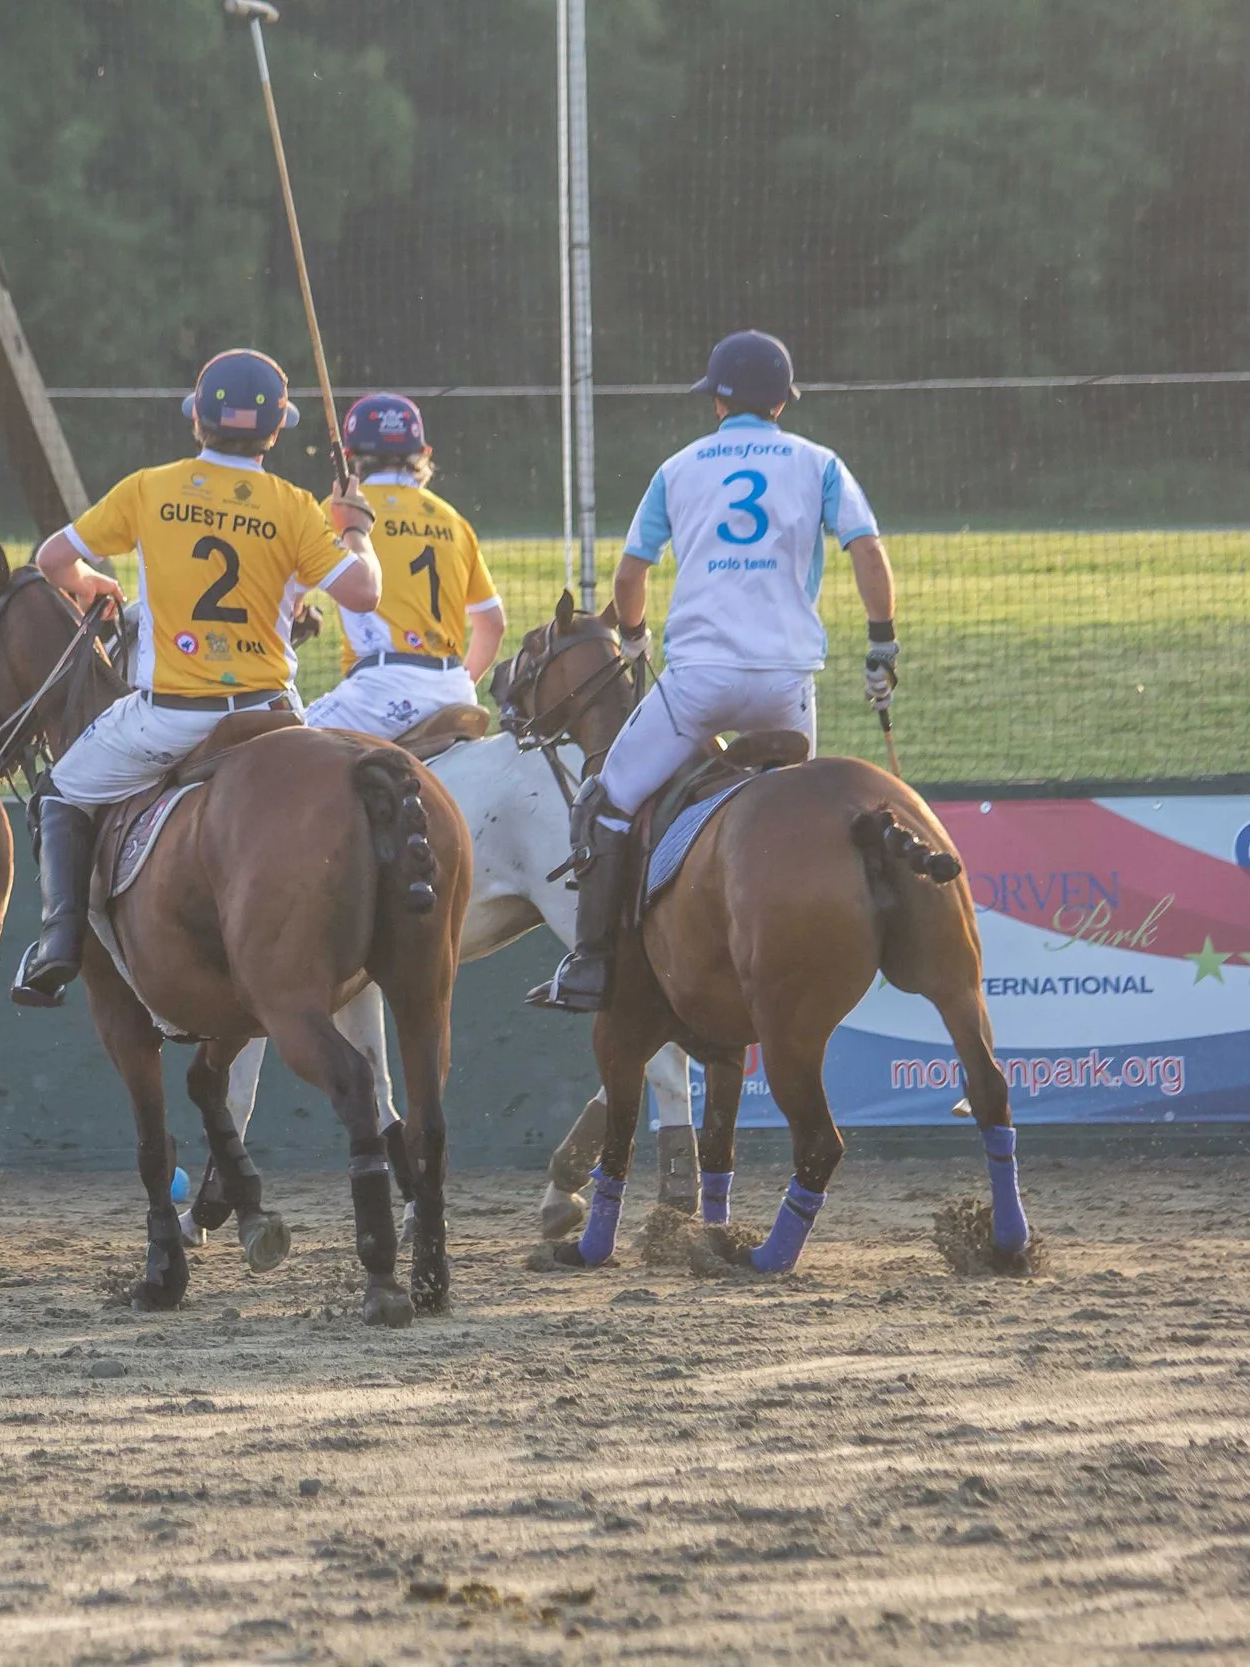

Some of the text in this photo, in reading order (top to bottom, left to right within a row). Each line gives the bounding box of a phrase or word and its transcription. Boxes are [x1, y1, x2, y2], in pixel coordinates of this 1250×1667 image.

[697, 442, 793, 460] salesforce
[160, 502, 228, 530] GUEST
[232, 514, 278, 540] PRO
[716, 469, 769, 546] 3
[384, 520, 455, 542] SALAHI
[191, 534, 249, 624] 2
[408, 544, 442, 624] 1
[708, 557, 777, 573] polo team
[968, 871, 1119, 914] ORVEN
[1043, 892, 1175, 952] Park
